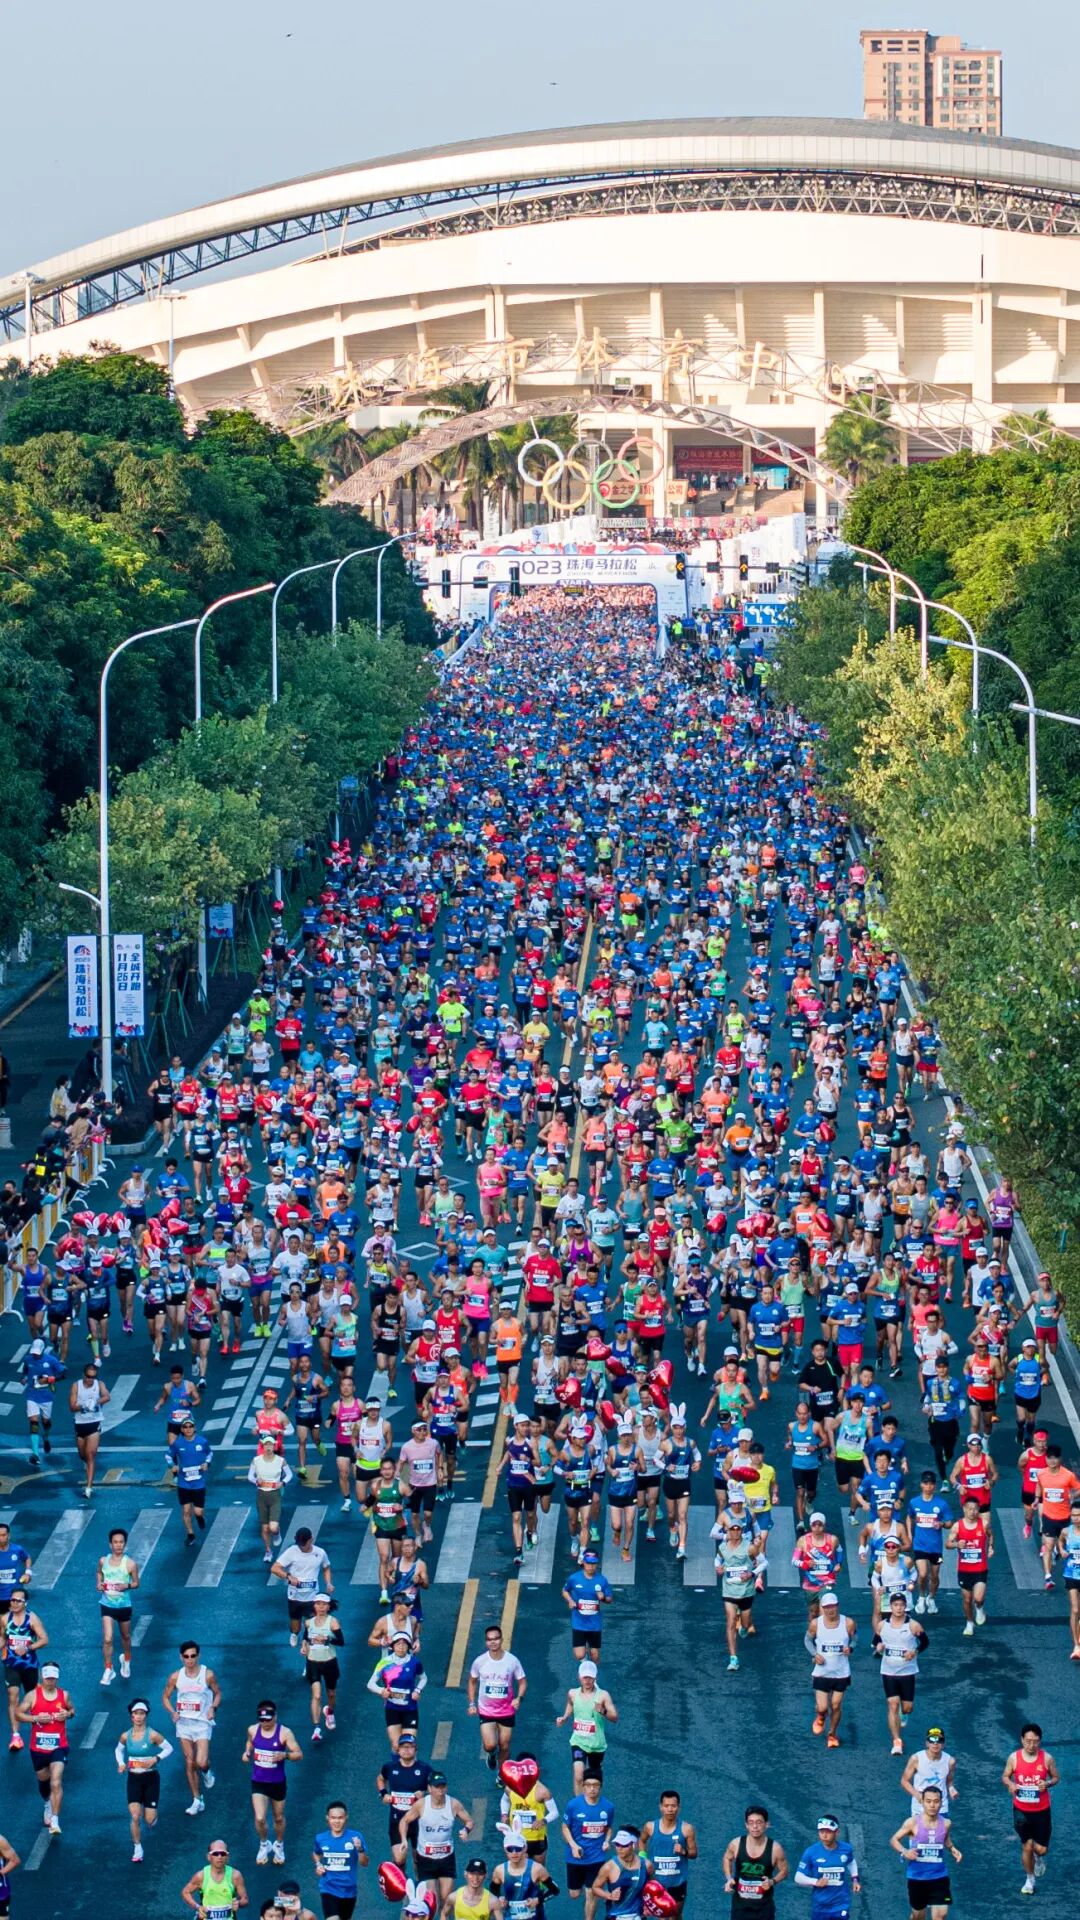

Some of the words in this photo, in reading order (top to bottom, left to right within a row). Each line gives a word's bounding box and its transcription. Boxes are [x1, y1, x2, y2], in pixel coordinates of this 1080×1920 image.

[567, 558, 638, 570] 珠海马拉松
[75, 964, 87, 1017] 珠海马拉松
[510, 1764, 537, 1777] 3:15
